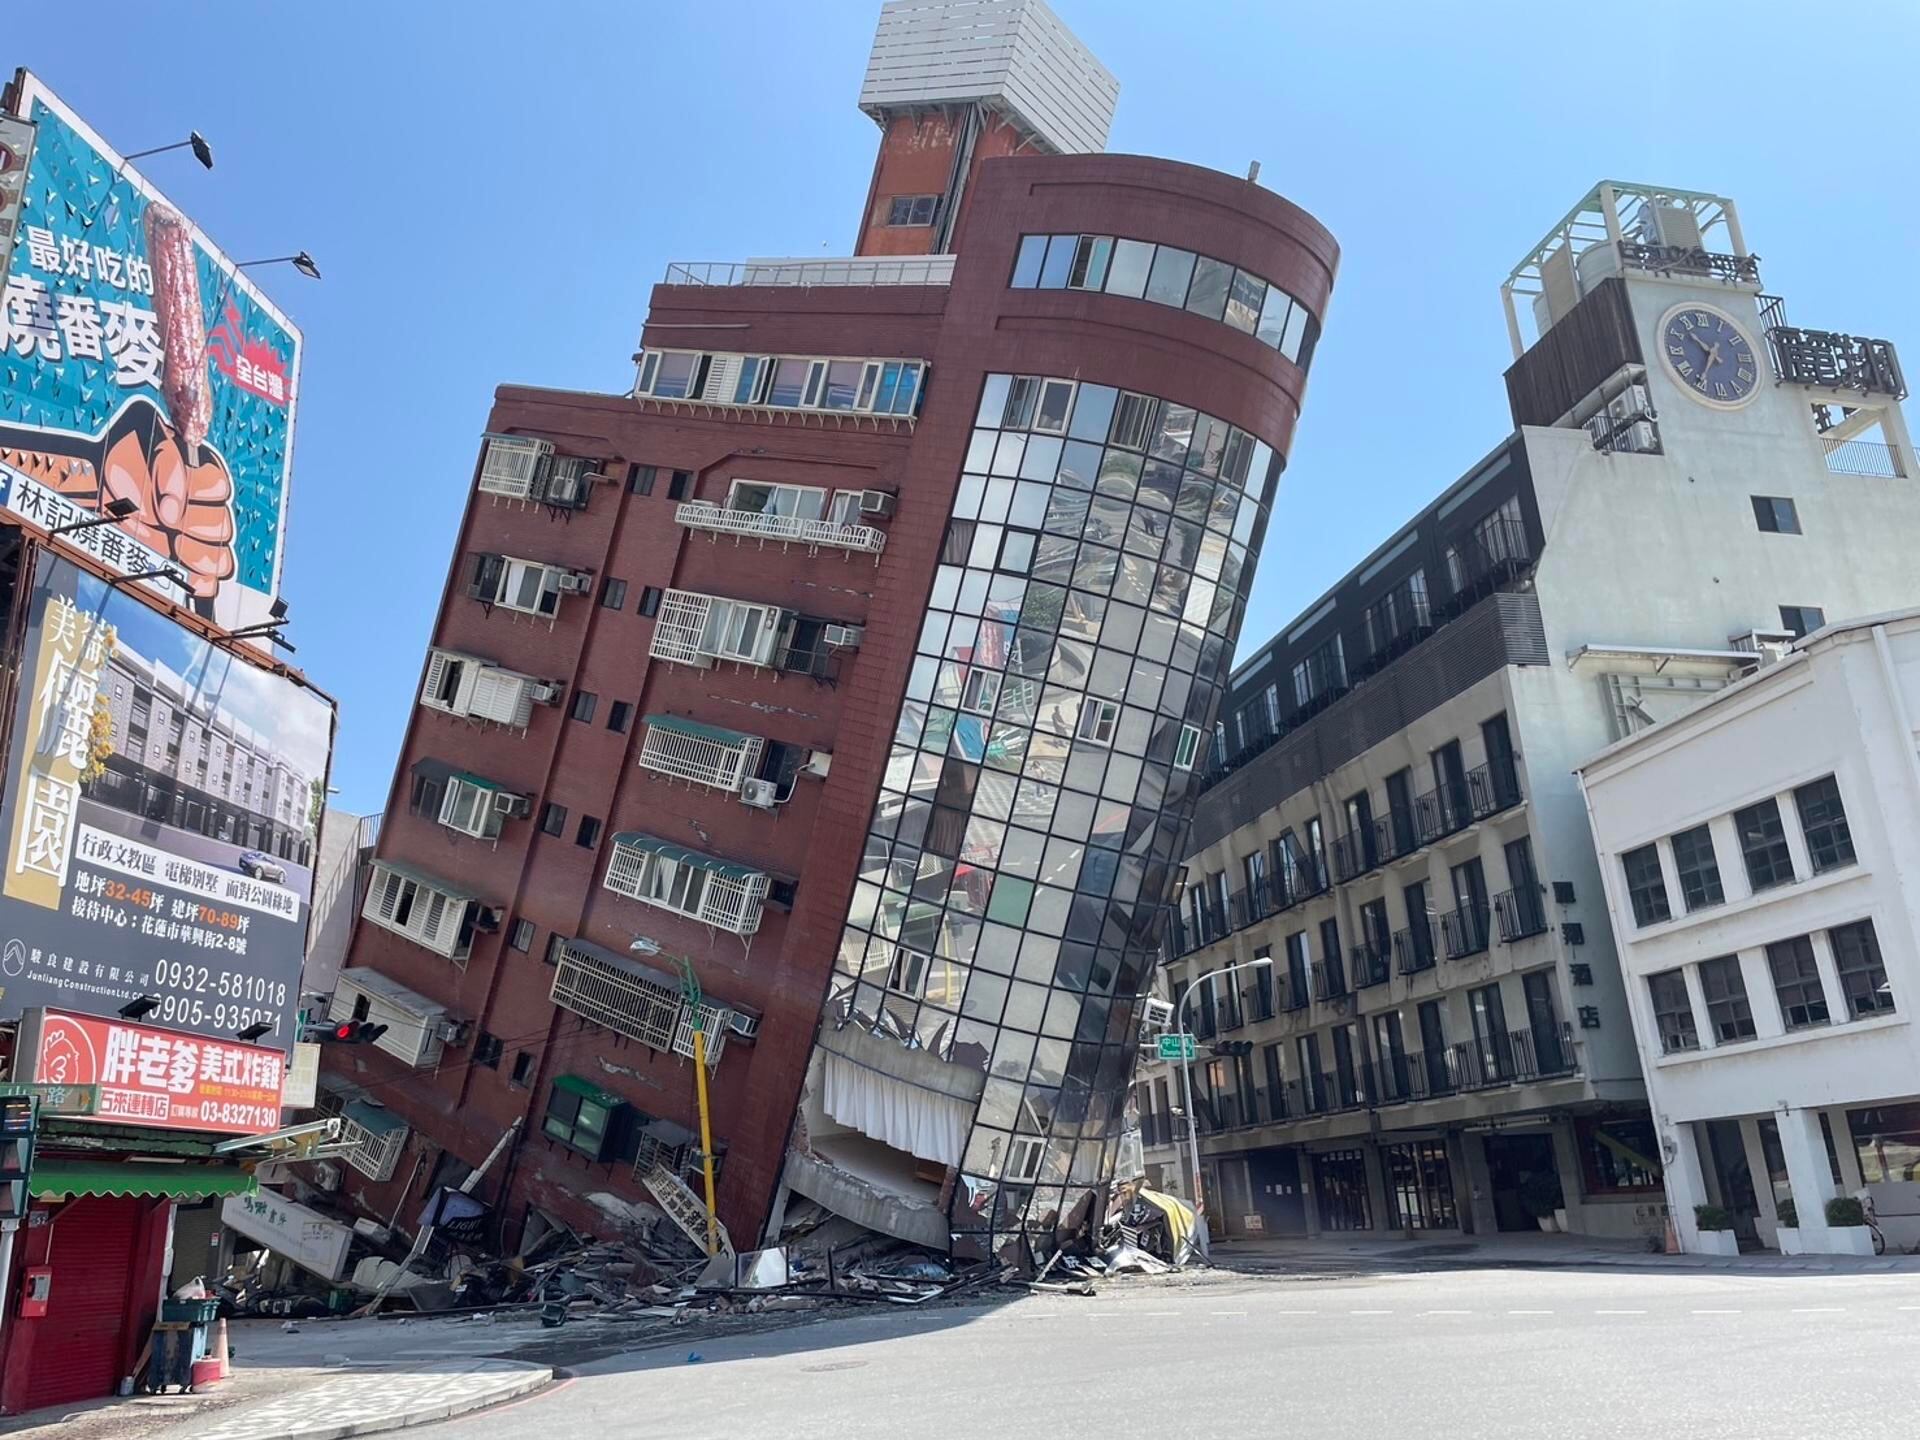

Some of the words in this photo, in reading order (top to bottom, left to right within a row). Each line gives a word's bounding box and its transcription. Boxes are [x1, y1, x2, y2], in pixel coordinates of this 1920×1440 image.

[26, 225, 154, 296] 最好吃的
[1728, 335, 1743, 346] II
[82, 832, 157, 876] 行政文教區
[74, 869, 165, 914] 地坪32-45坪
[155, 959, 286, 1007] 0932-581018
[100, 1026, 198, 1095] 胖老爹
[200, 1044, 281, 1091] 美式炸雞
[201, 1100, 276, 1128] 03-8327130
